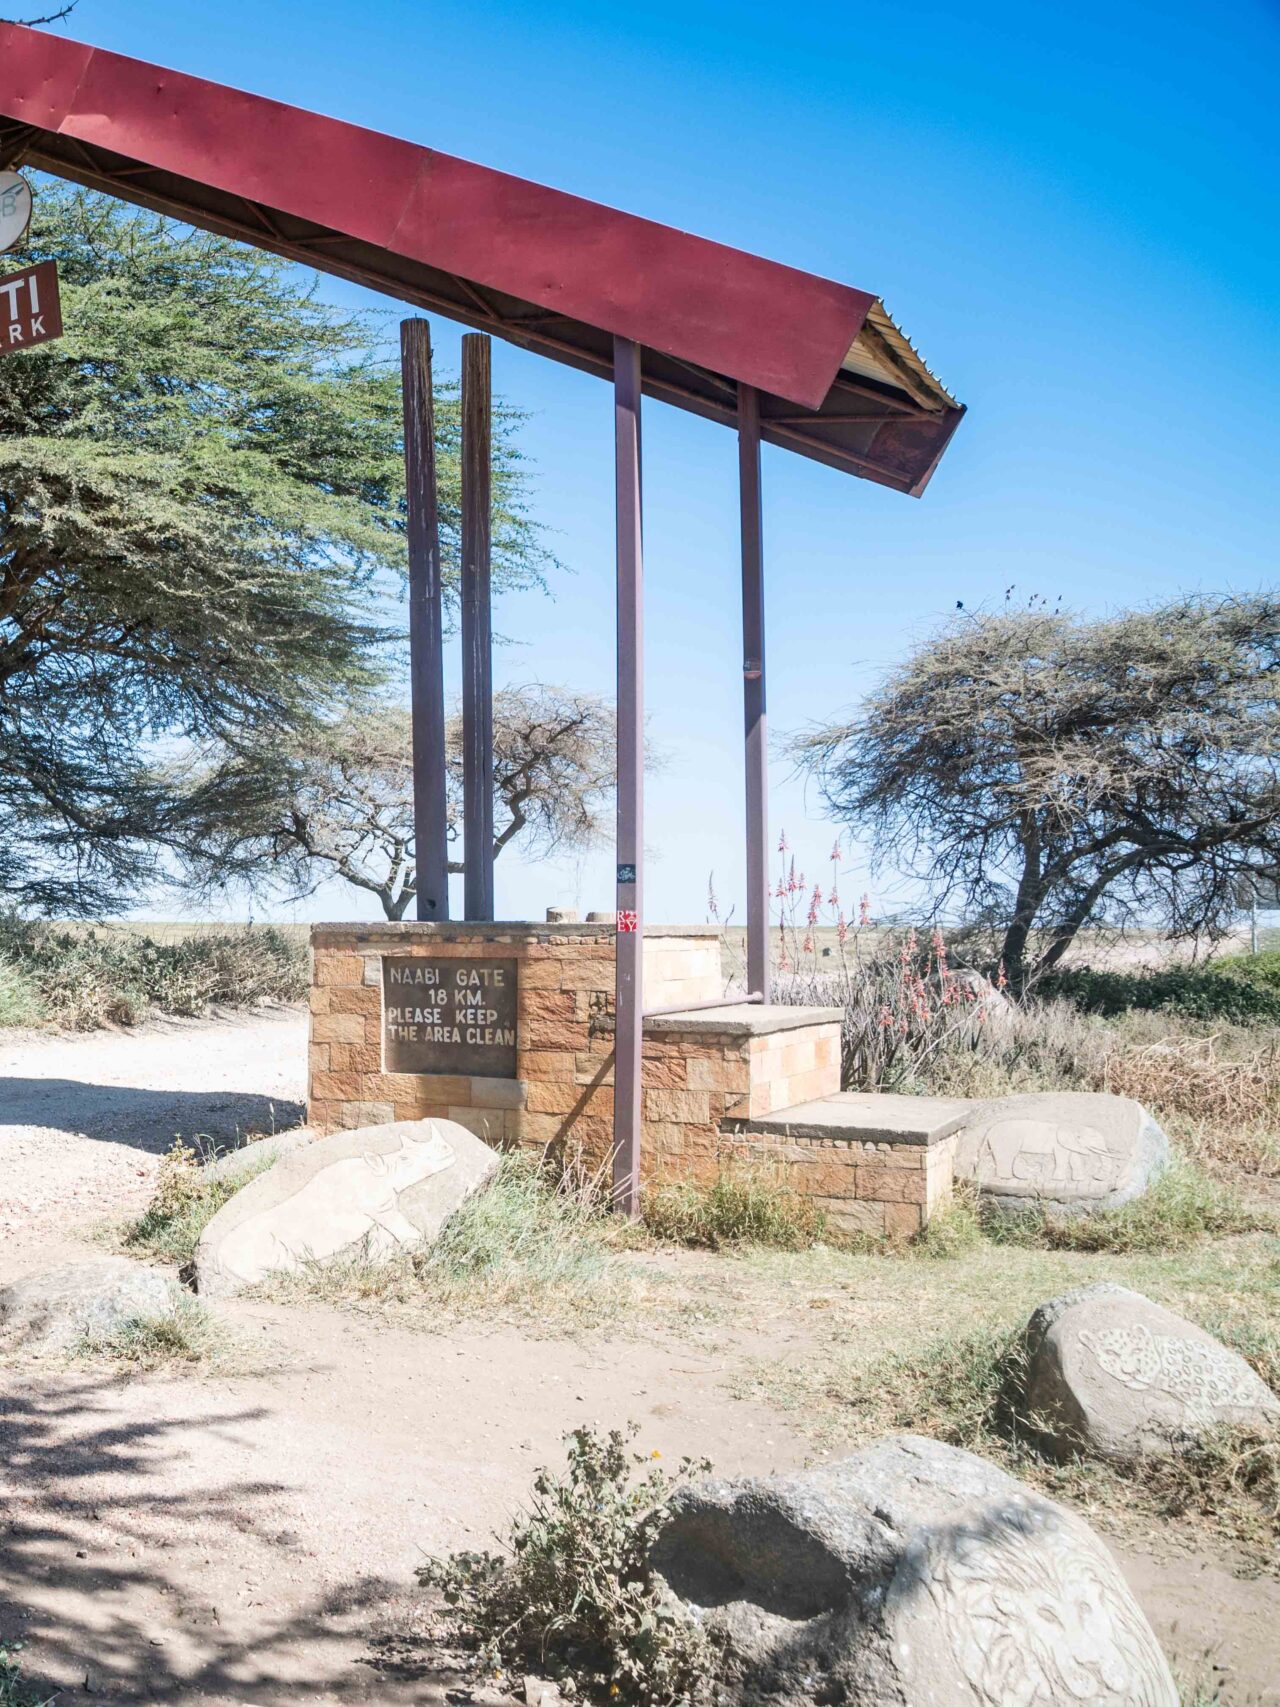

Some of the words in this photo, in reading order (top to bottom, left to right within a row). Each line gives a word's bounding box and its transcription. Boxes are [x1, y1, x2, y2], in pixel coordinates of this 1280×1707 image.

[390, 967, 439, 985] NAABI
[456, 969, 505, 987] GATE
[428, 989, 448, 1005] 18
[454, 989, 486, 1006] KM.
[387, 1007, 442, 1024] PLEASE
[455, 1008, 498, 1025] KEEP
[388, 1025, 418, 1042] THE
[425, 1026, 461, 1043] AREA
[466, 1028, 515, 1046] CLEAN
